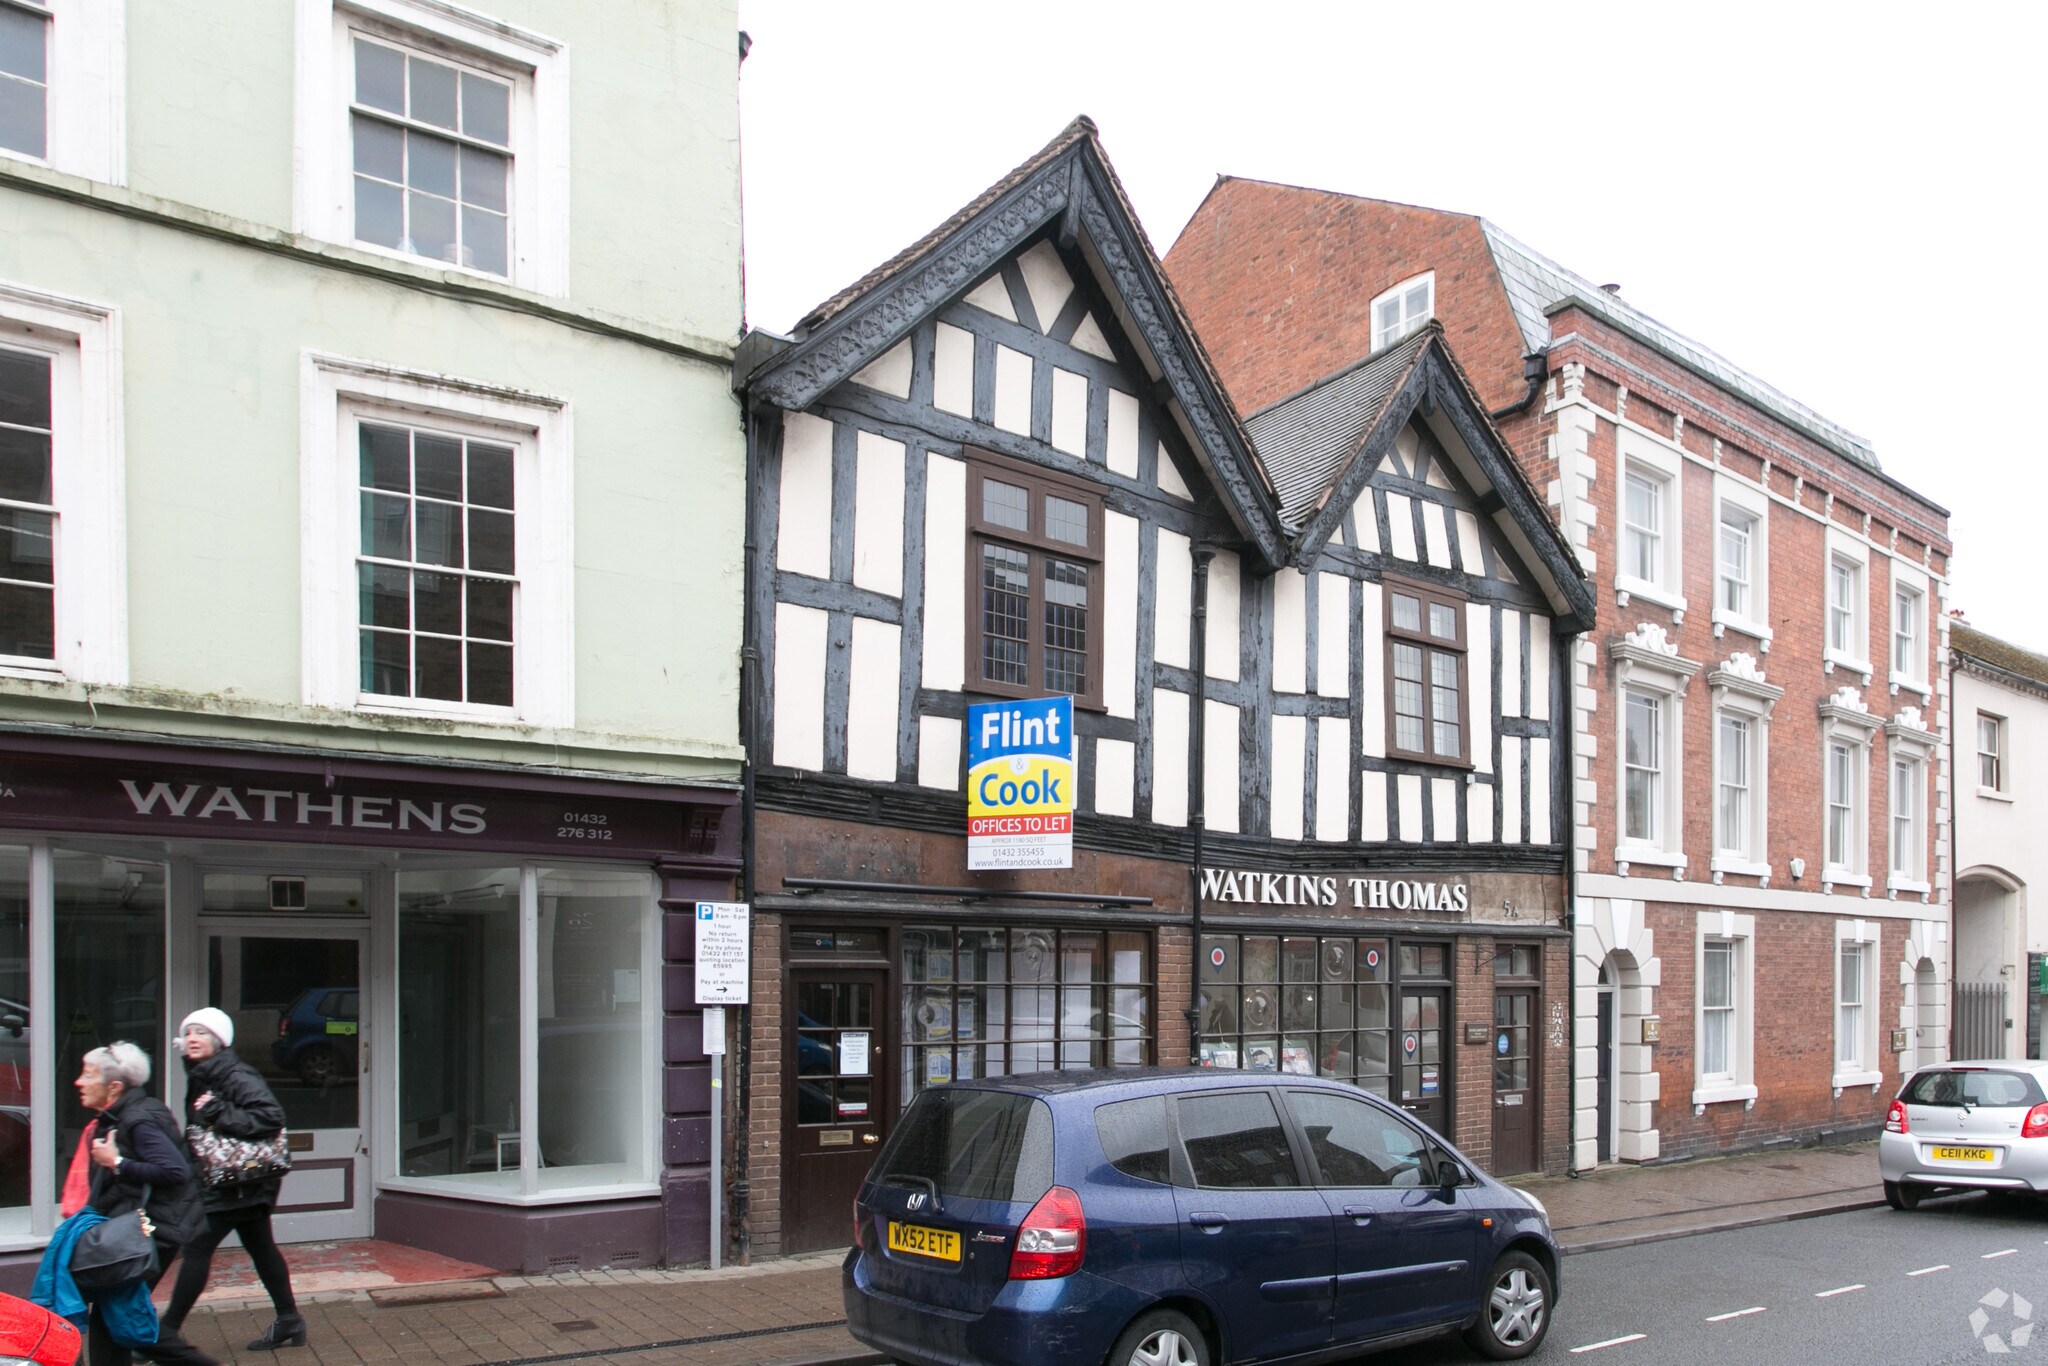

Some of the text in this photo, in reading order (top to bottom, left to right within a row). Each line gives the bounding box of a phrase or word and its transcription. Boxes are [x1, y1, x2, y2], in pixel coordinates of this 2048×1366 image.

[981, 707, 1061, 749] Flint
[1015, 757, 1024, 771] &
[979, 768, 1062, 807] Cook
[117, 779, 487, 835] WATHENS
[563, 812, 608, 825] 01432
[971, 816, 1068, 834] OFFICES TO LET
[557, 827, 613, 841] 276 312
[992, 847, 1045, 857] 01432 355455
[974, 857, 1064, 868] www.flintandcook.co.uk
[1192, 868, 1468, 912] WATKINS THOMAS
[701, 905, 712, 919] P
[1940, 1148, 1986, 1159] CE11 KKG
[894, 1228, 925, 1250] WX52
[928, 1231, 954, 1255] ETF
